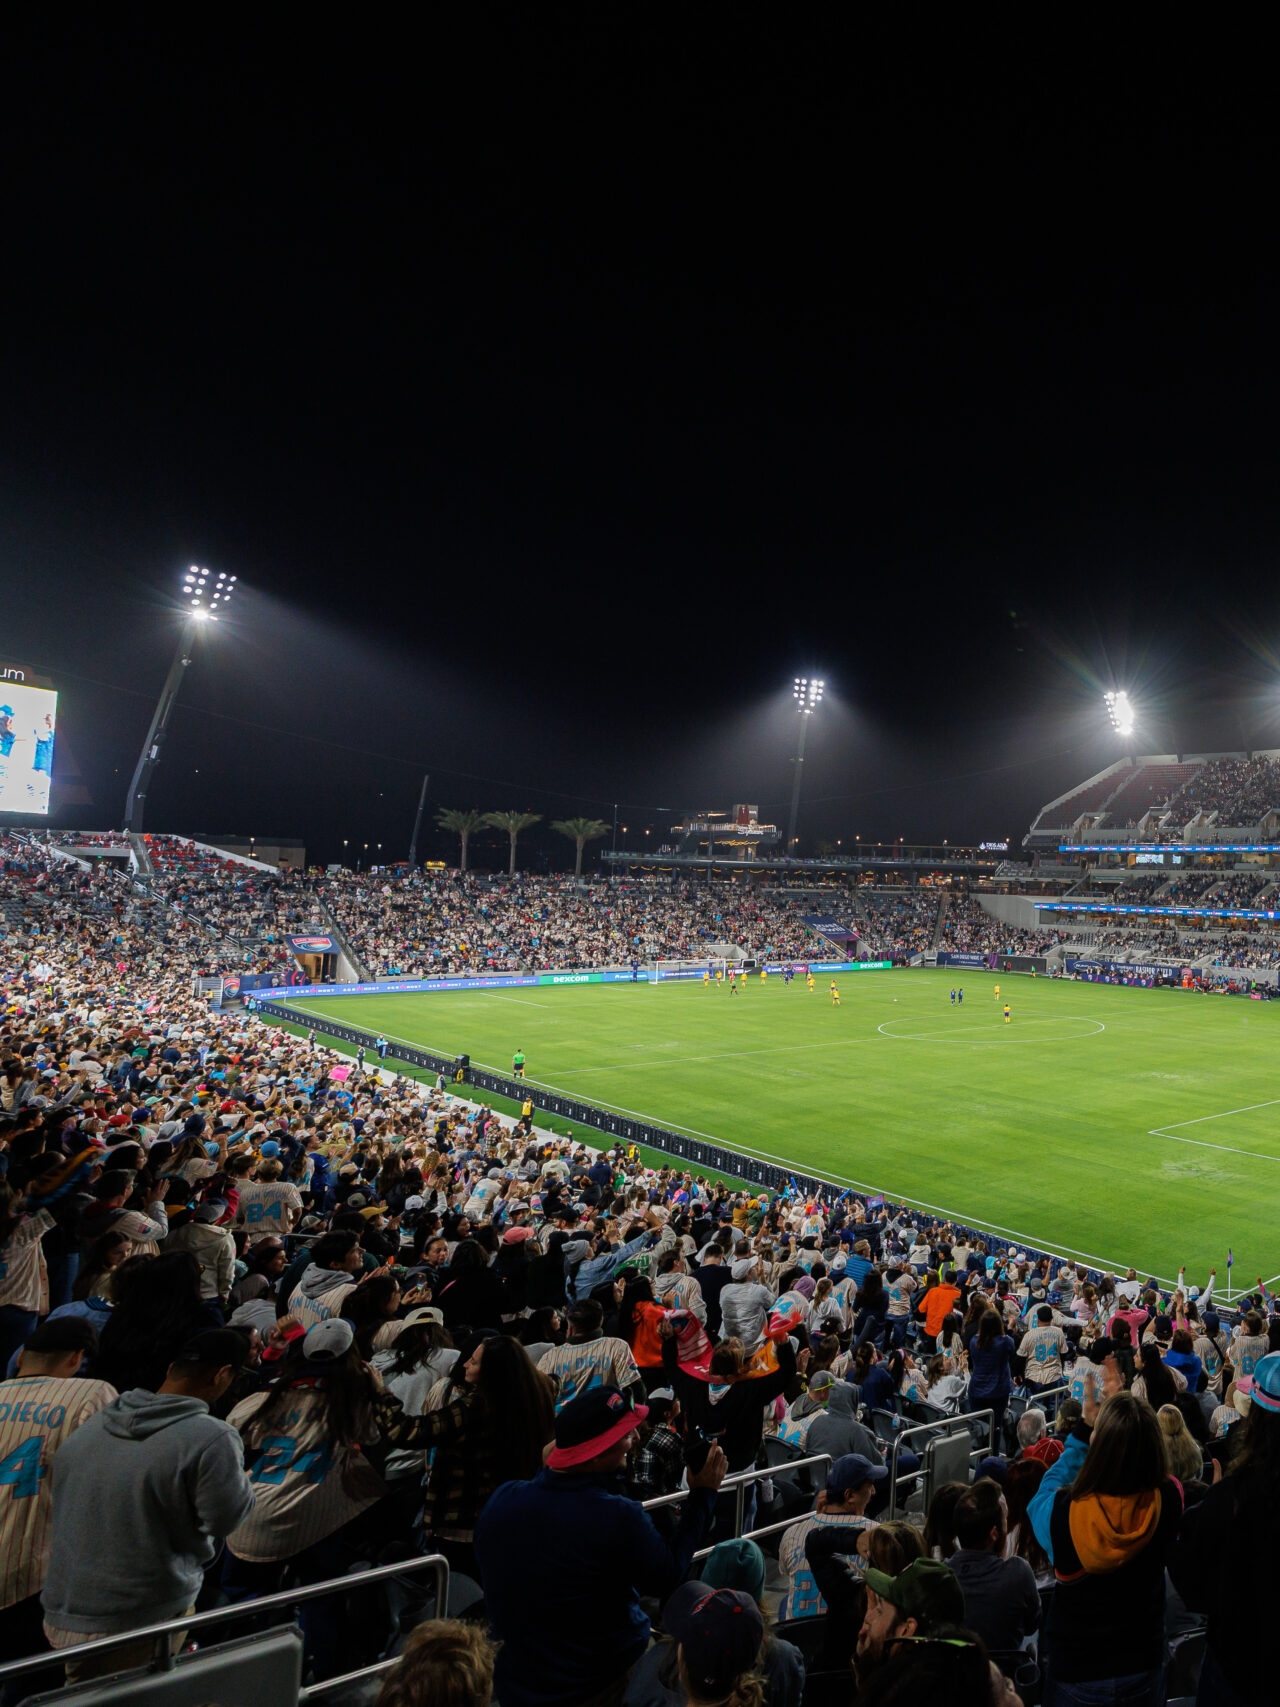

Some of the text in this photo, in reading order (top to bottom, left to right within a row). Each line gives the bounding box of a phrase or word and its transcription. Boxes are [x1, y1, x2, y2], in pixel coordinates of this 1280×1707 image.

[304, 1297, 331, 1321] DIEGO
[0, 1402, 66, 1429] DIEGO
[250, 1437, 334, 1484] 24
